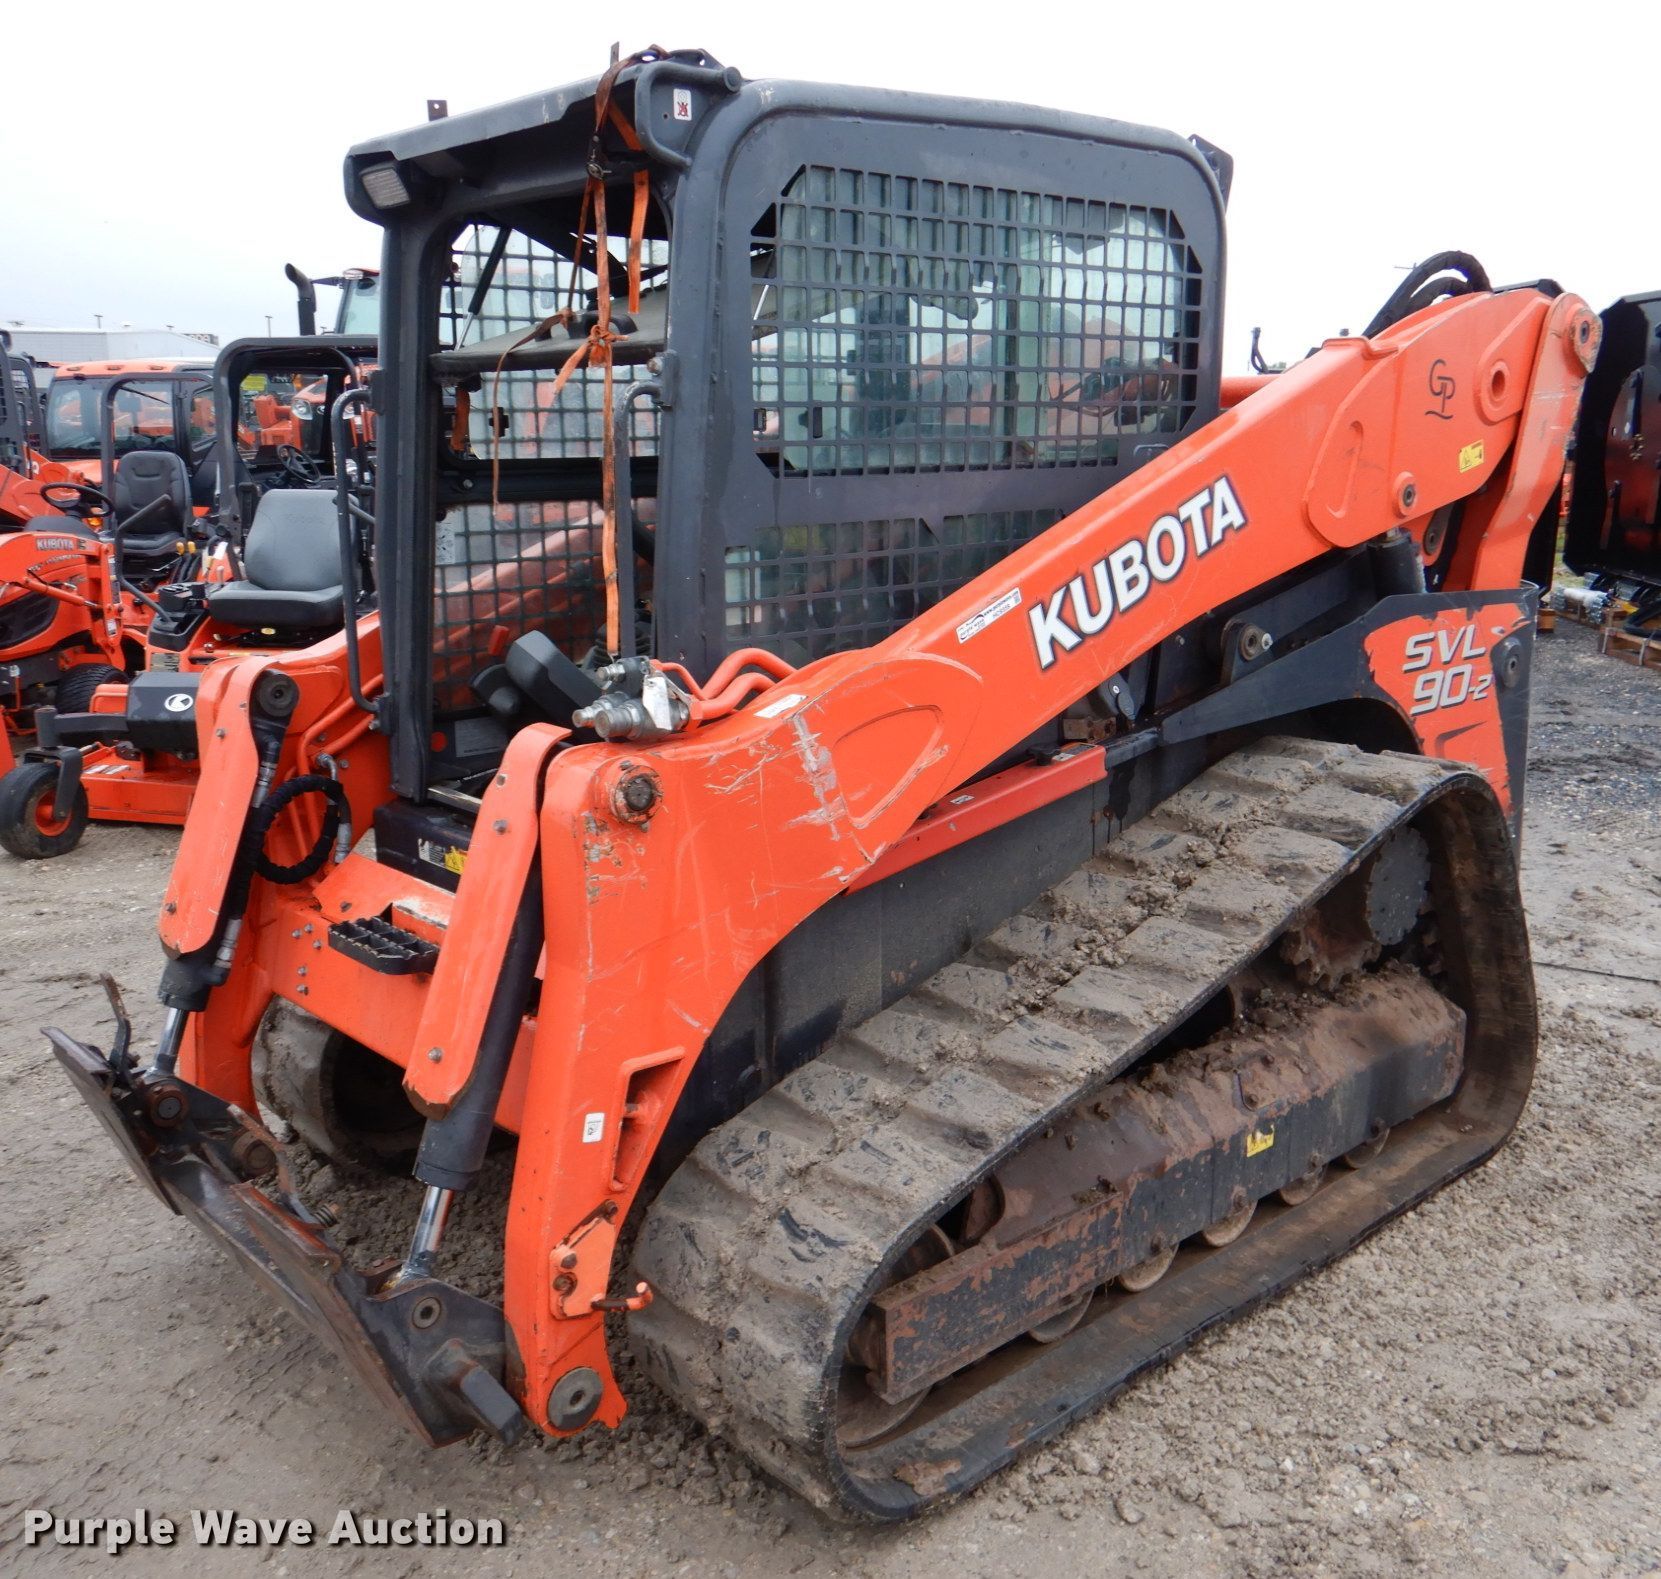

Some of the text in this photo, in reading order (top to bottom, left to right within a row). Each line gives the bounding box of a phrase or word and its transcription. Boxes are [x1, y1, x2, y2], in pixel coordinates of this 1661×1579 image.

[36, 538, 75, 551] KUBOTA
[1028, 475, 1247, 671] KUBOTA
[1402, 624, 1487, 673] SVL
[1409, 663, 1494, 716] 90-2
